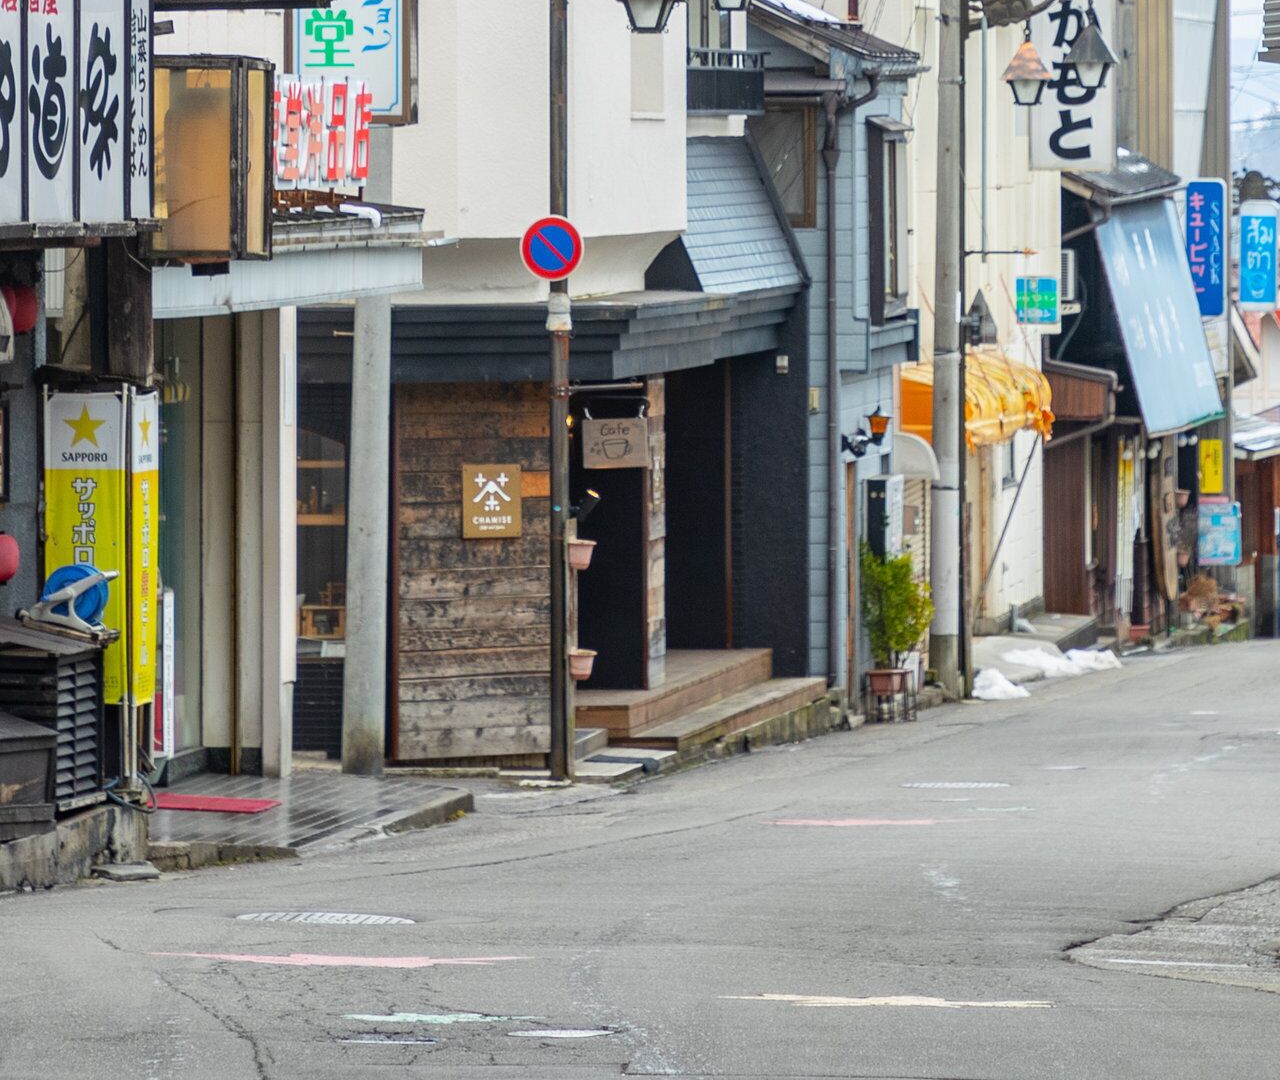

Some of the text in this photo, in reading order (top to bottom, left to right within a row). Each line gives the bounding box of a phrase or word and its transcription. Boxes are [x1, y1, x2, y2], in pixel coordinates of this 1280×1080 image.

[137, 8, 149, 174] 山菜らーめん
[600, 422, 630, 437] Cafe
[61, 452, 108, 463] SAPPORO
[71, 477, 98, 567] サッポロ
